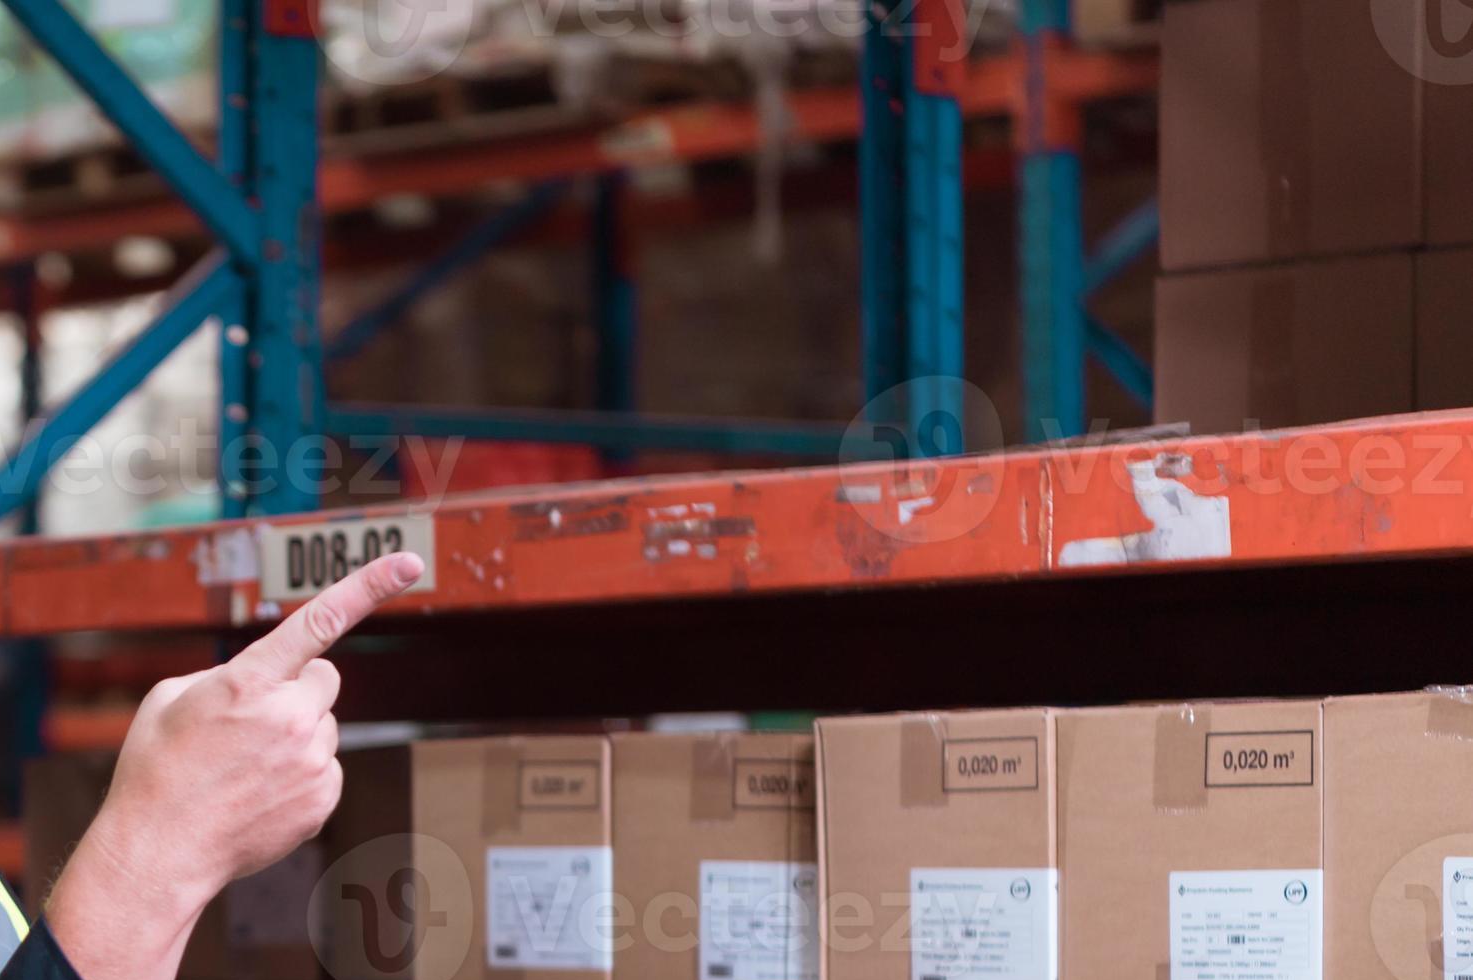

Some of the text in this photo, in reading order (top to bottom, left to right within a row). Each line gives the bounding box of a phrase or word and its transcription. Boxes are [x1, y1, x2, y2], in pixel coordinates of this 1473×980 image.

[958, 755, 998, 777] 0,020
[1223, 750, 1294, 773] 0,020 m³
